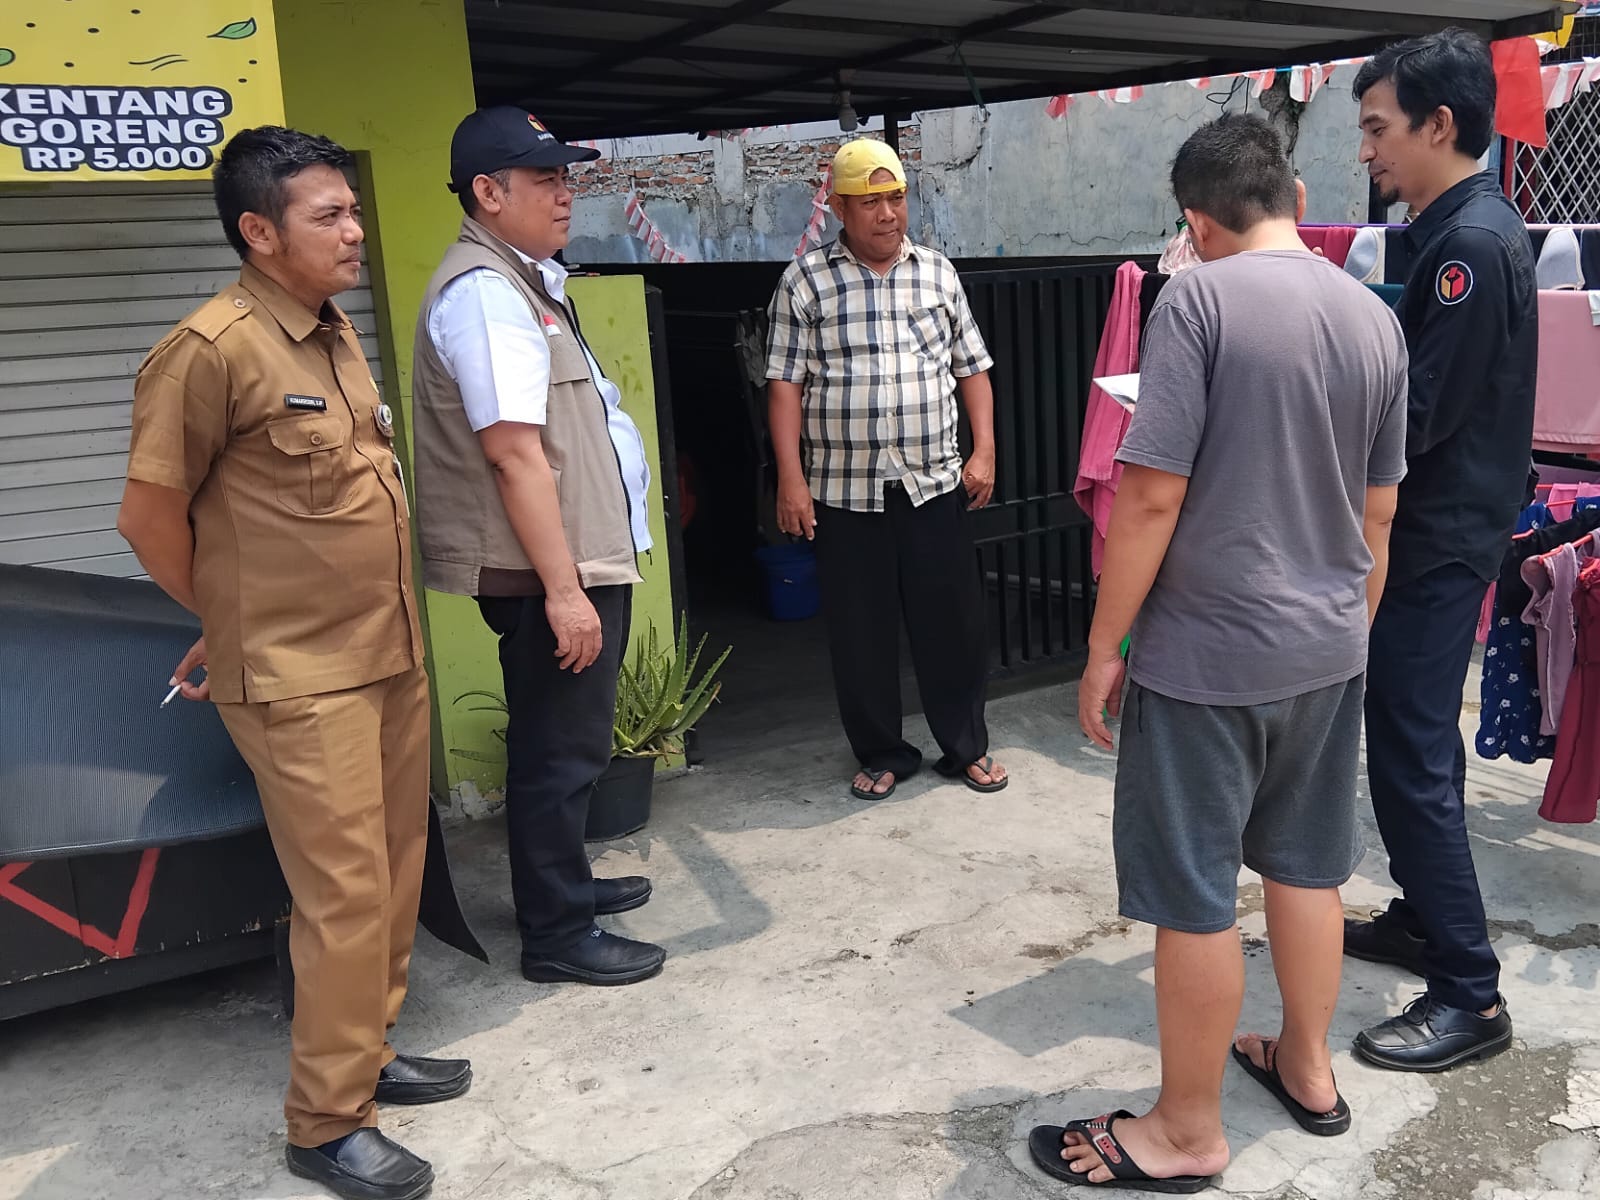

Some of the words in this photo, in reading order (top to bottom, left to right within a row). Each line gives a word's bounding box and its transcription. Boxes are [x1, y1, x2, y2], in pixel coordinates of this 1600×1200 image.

[1, 118, 217, 144] GORENG
[28, 147, 85, 169] RP
[94, 147, 207, 169] 5.000
